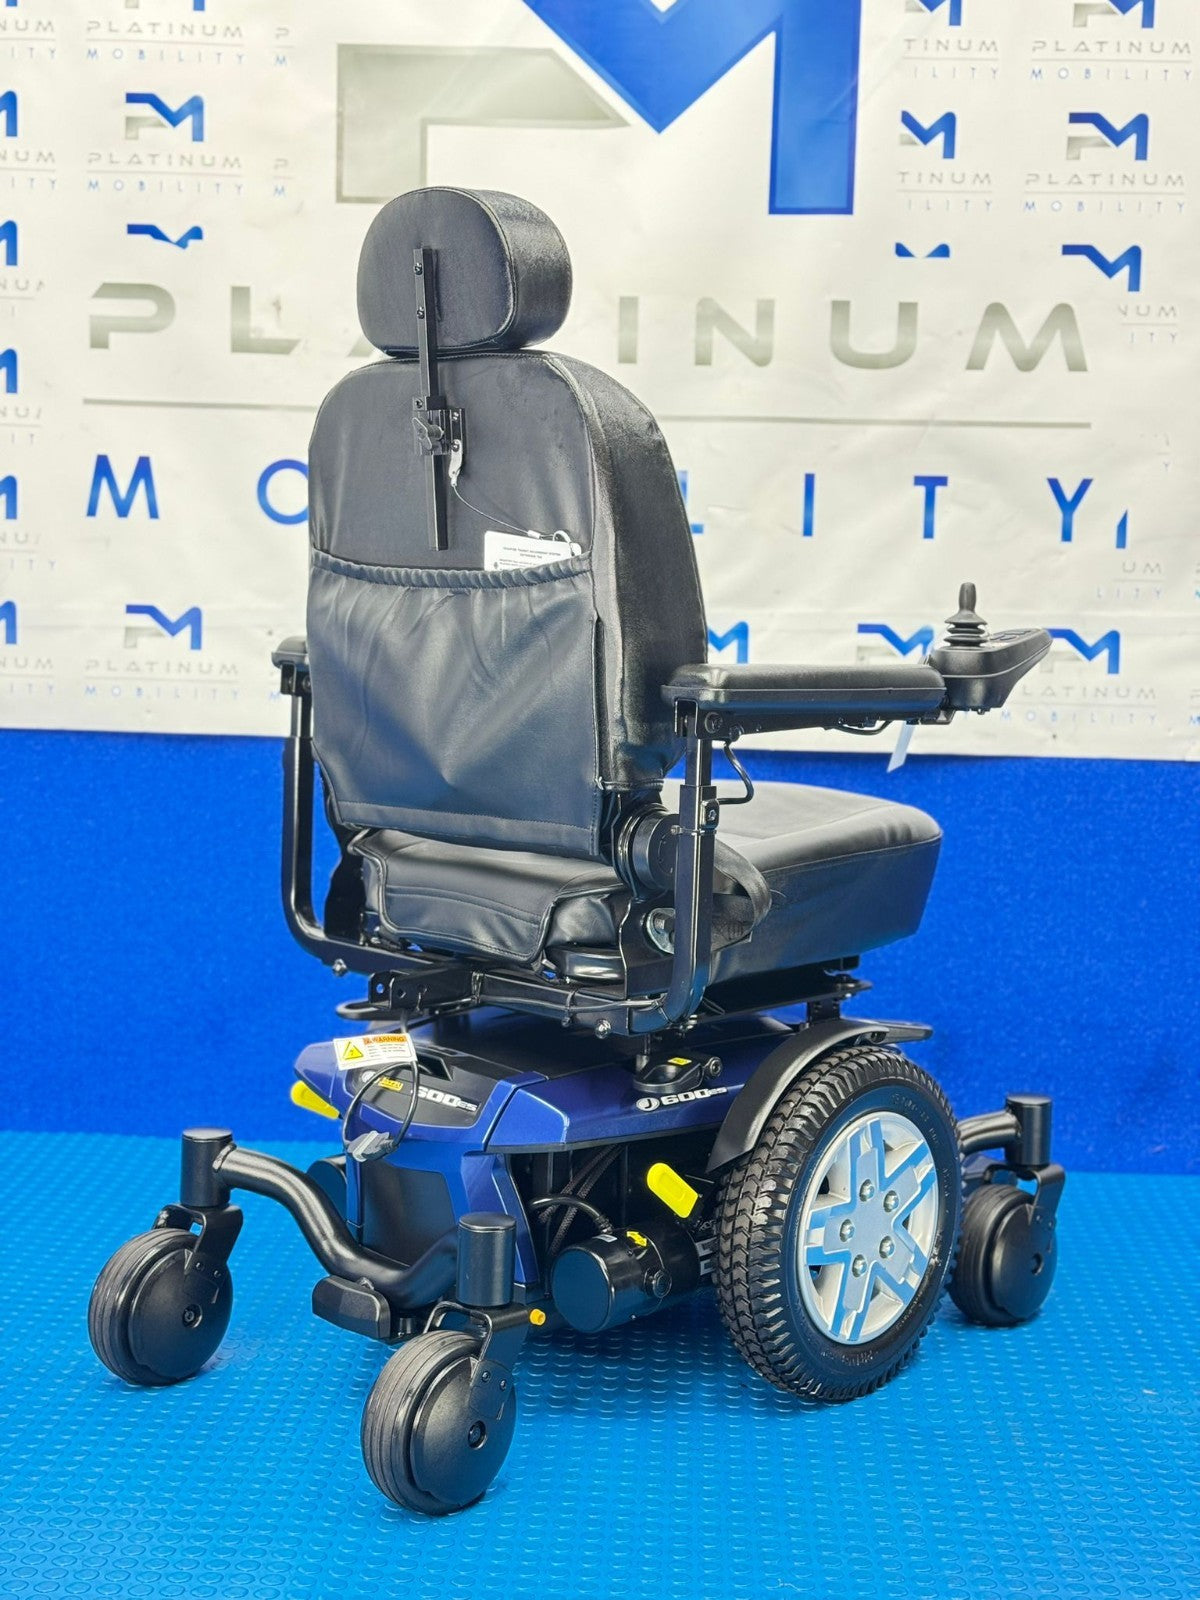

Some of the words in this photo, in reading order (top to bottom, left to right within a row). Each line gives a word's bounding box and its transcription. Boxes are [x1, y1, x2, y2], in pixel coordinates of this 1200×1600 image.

[86, 20, 243, 39] PLATINUM
[1031, 40, 1191, 54] PLATINUM
[87, 48, 244, 65] MOBILITY
[1030, 68, 1192, 81] MOBILITY
[87, 152, 242, 169] PLATINUM
[88, 179, 243, 195] MOBILITY
[1024, 173, 1185, 187] PLATINUM
[1023, 201, 1185, 214] MOBILITY
[85, 659, 238, 676] PLATINUM
[85, 685, 239, 699] MOBILITY
[1022, 684, 1157, 700] LATINUM
